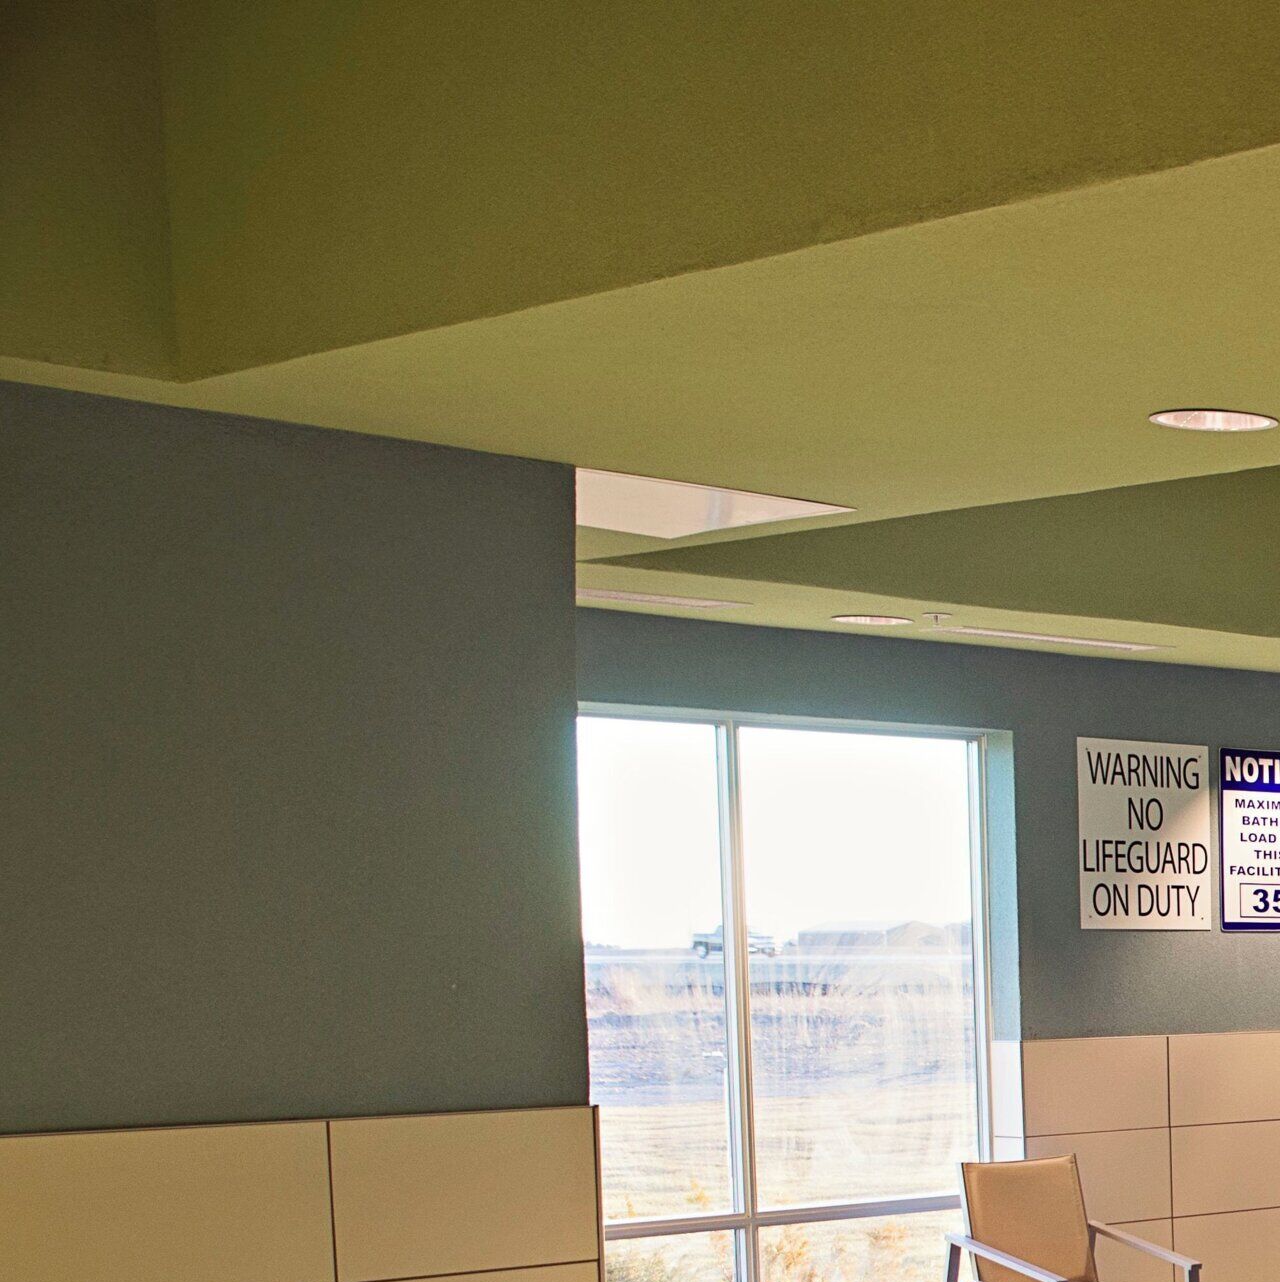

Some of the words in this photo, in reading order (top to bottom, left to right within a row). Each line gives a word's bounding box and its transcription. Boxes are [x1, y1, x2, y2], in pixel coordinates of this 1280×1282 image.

[1087, 751, 1199, 790] WARNING
[1128, 797, 1163, 831] NO
[1240, 832, 1277, 844] LOAD
[1083, 839, 1208, 875] LIFEGUARD
[1093, 883, 1129, 917] ON
[1138, 884, 1200, 917] DUTY
